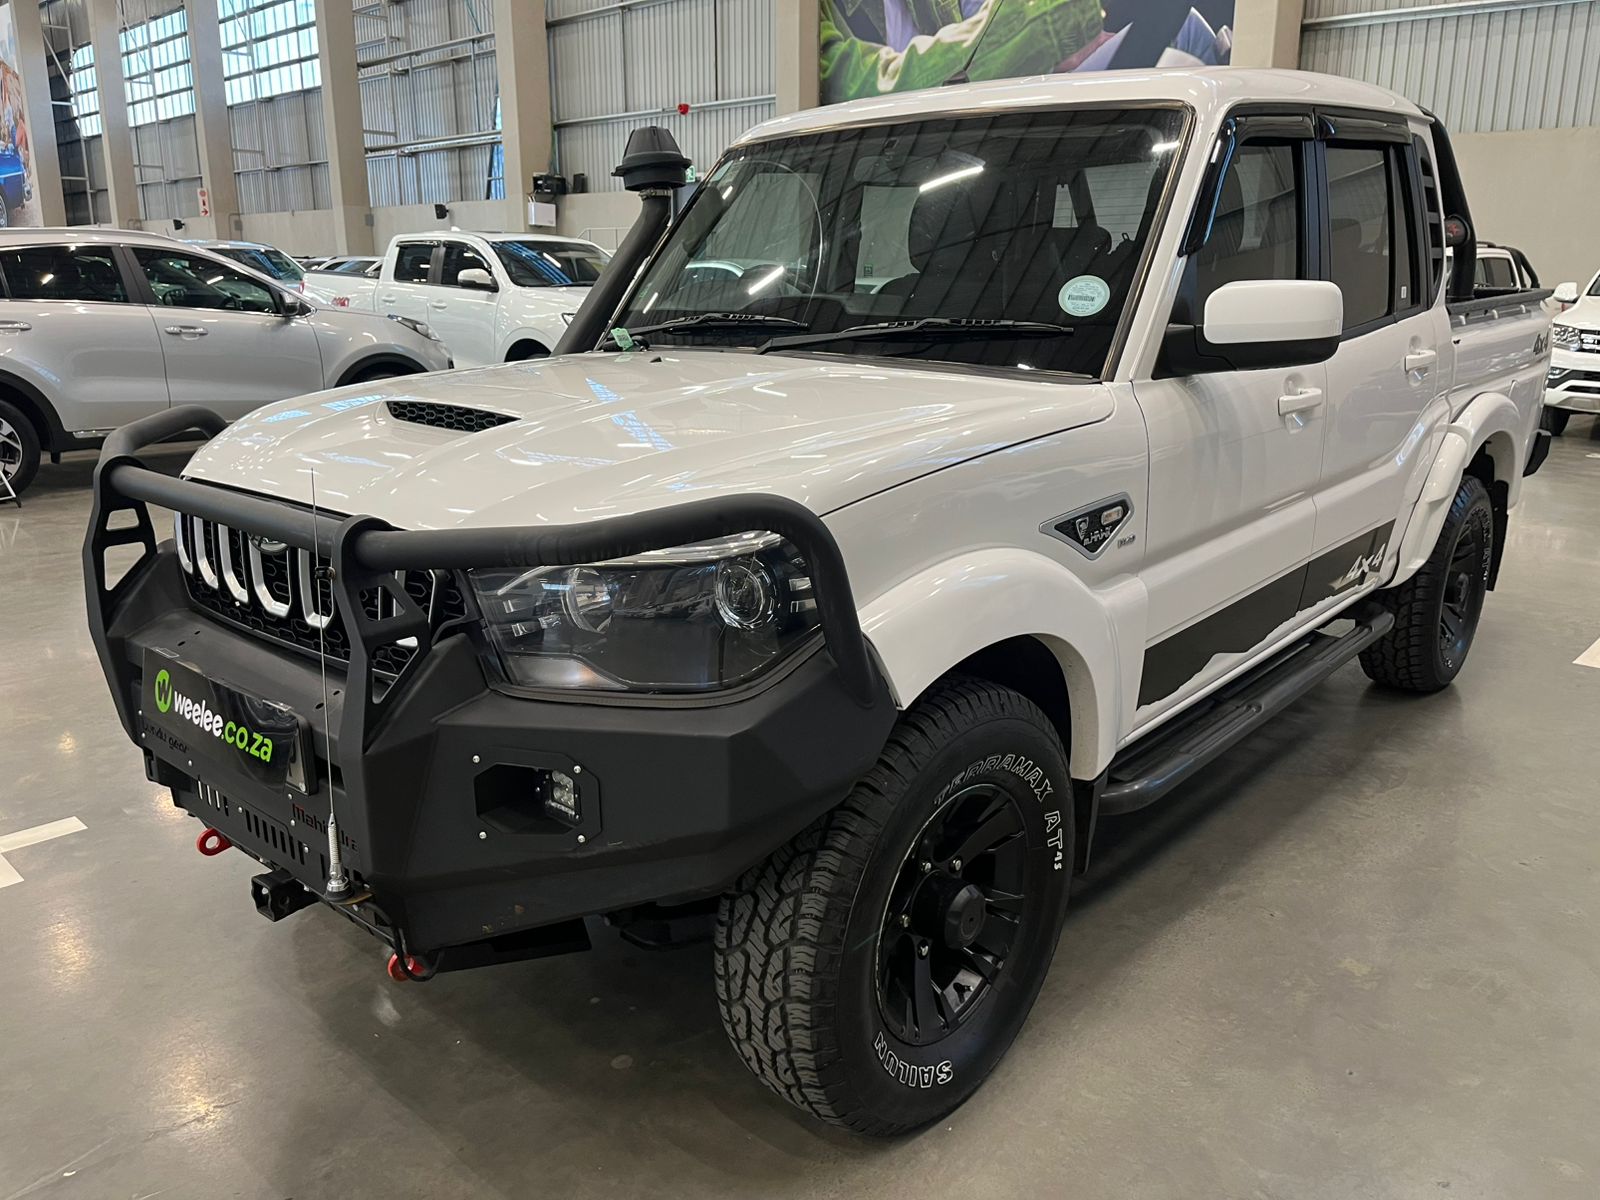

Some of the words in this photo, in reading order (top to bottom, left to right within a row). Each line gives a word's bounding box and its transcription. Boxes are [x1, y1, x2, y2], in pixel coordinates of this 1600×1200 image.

[174, 690, 273, 762] weelee.co.za
[934, 754, 1054, 805] TERRAMAX
[873, 1031, 954, 1089] SAILUN
